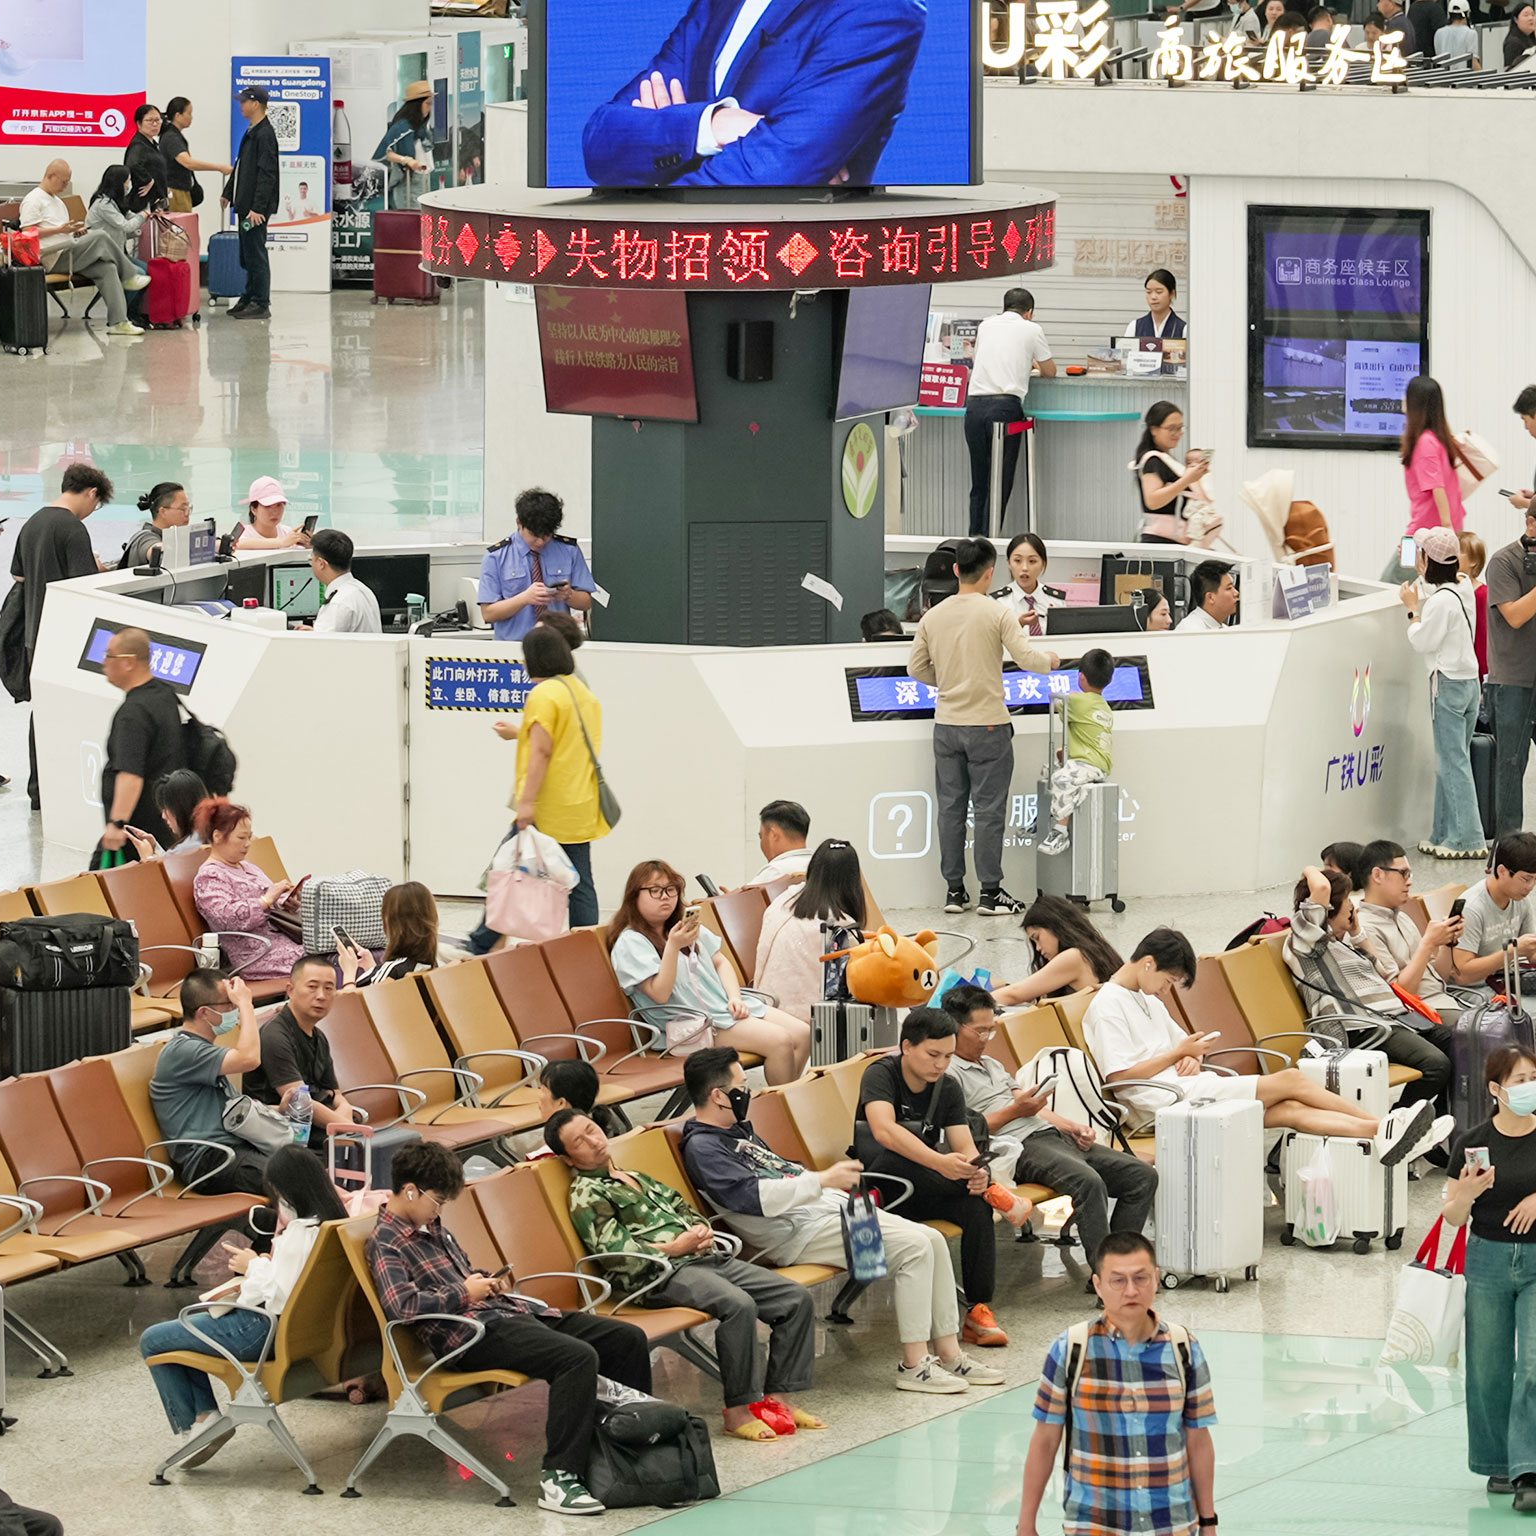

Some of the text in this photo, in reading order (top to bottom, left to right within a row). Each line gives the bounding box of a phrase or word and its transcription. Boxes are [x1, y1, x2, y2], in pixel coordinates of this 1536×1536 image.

[1149, 14, 1409, 86] 商旅服务区
[236, 78, 326, 89] Welcome to Guangdong
[284, 90, 317, 99] OneStop
[566, 220, 996, 284] 失物招领 咨询引导
[1304, 258, 1410, 278] 商务座候车区
[1305, 276, 1411, 289] Business Class Lounge
[546, 321, 682, 348] 坚持以人民为中心的发展理念
[554, 349, 679, 374] 践行人民铁路为人民的宗旨
[1324, 743, 1385, 793] 广铁U彩
